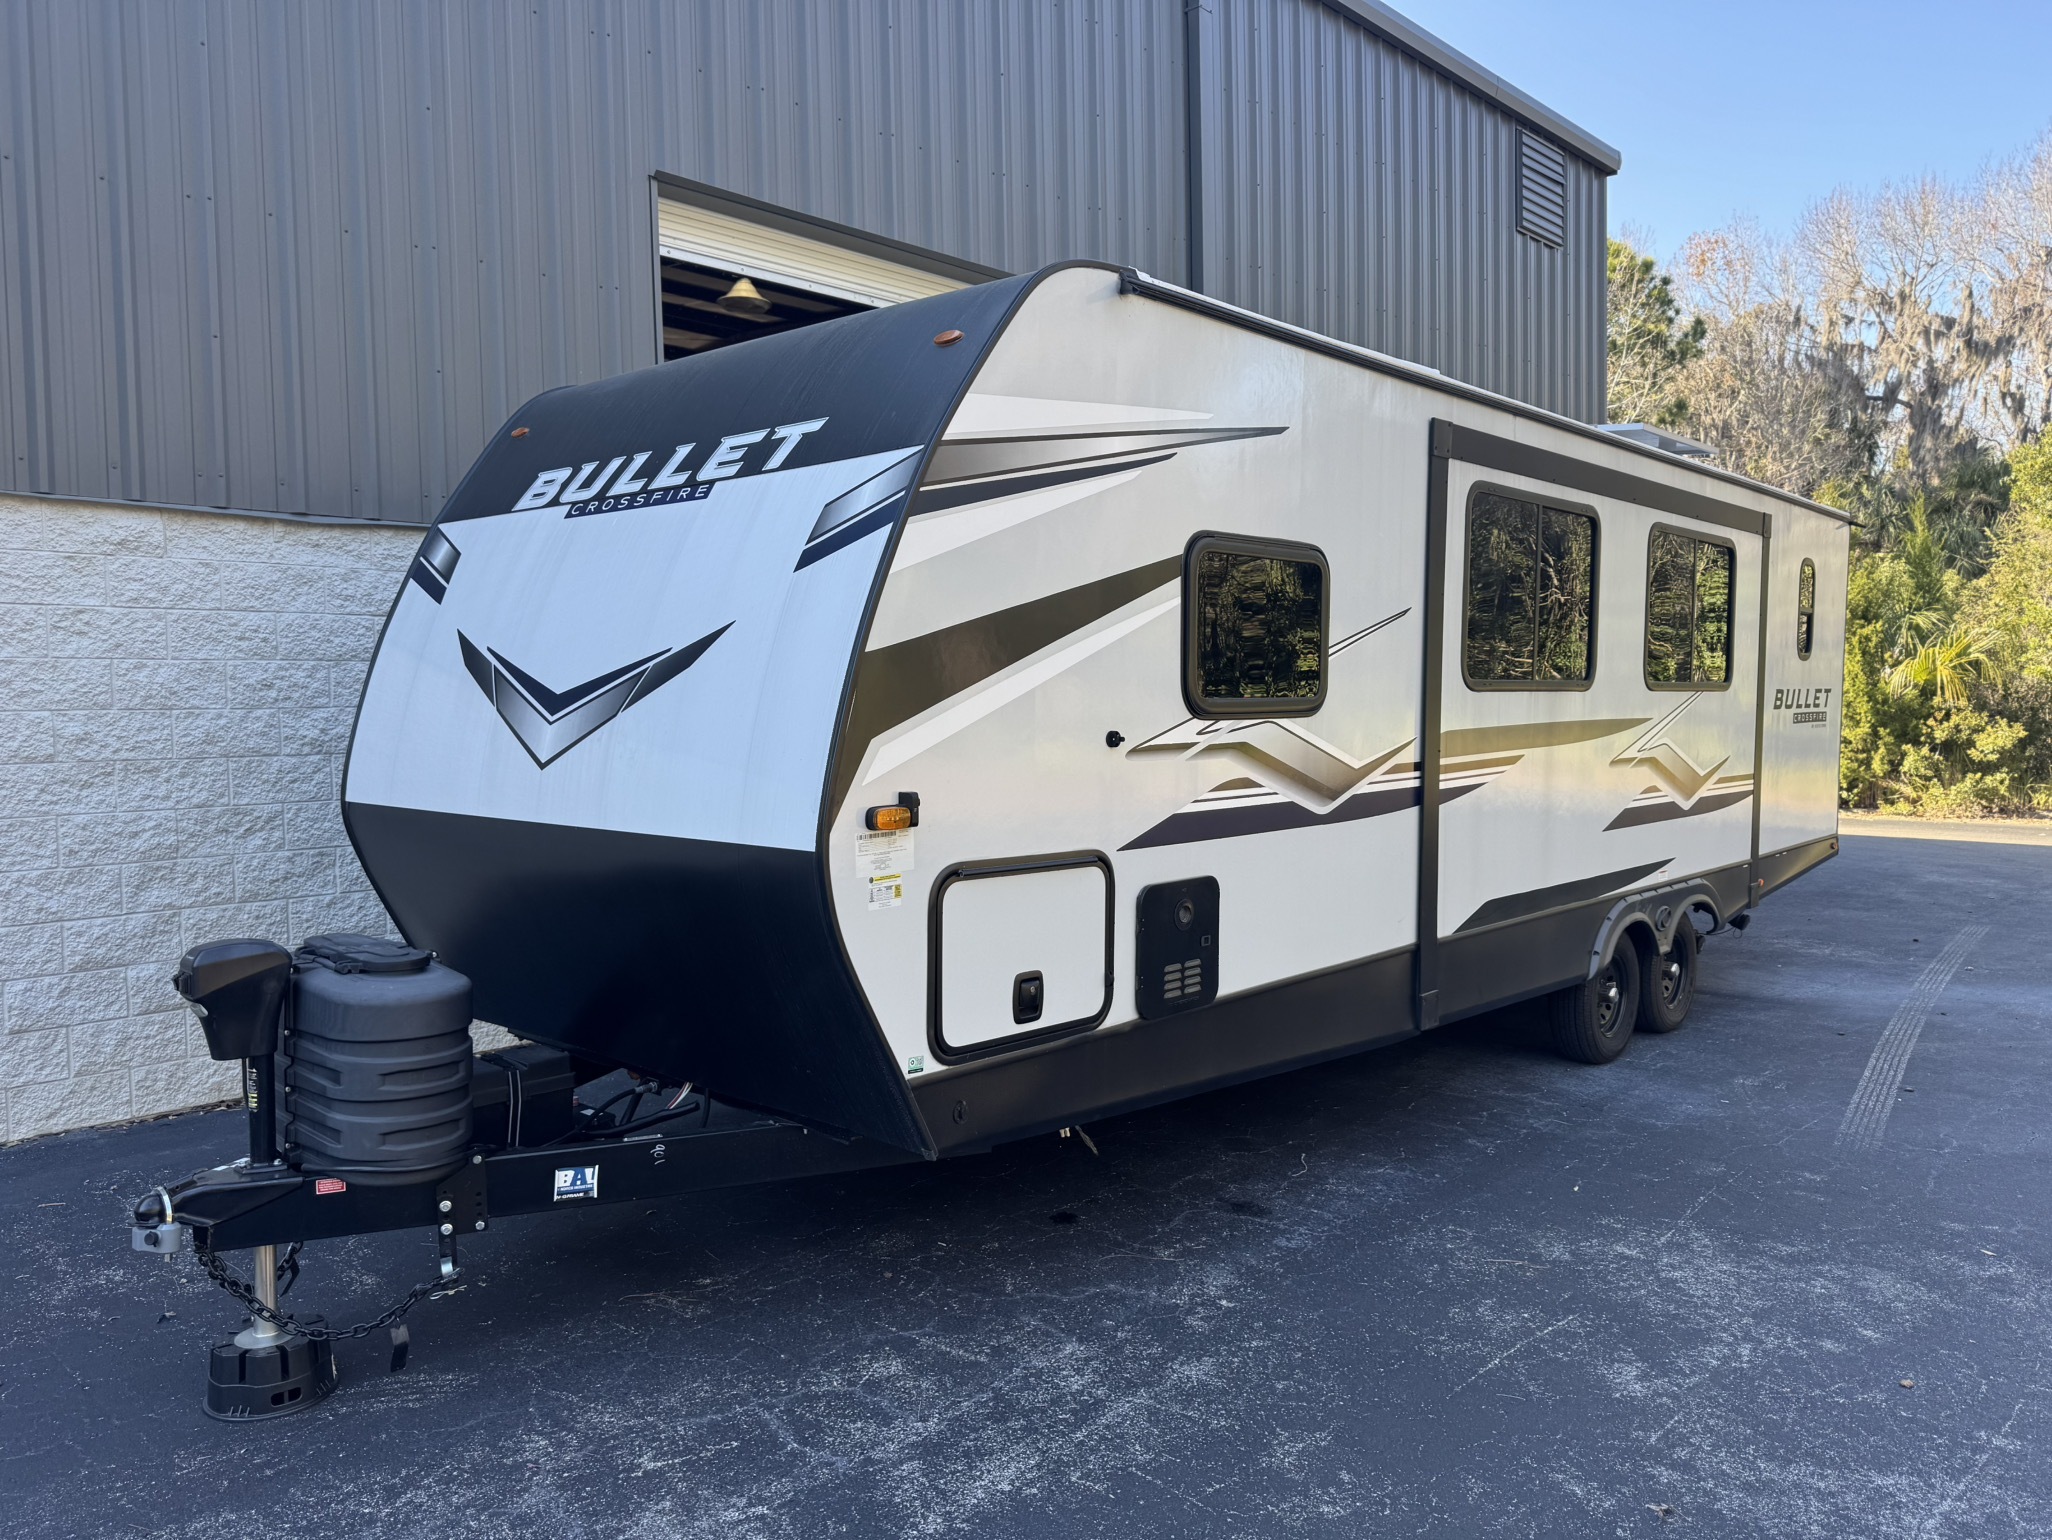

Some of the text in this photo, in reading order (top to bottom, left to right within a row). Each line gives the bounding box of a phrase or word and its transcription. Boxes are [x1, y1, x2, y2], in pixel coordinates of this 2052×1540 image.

[511, 416, 829, 511] BULLET
[571, 485, 710, 515] CROSSFIRE
[1773, 688, 1832, 710] BULLET
[1793, 712, 1827, 723] CROSSFIRE
